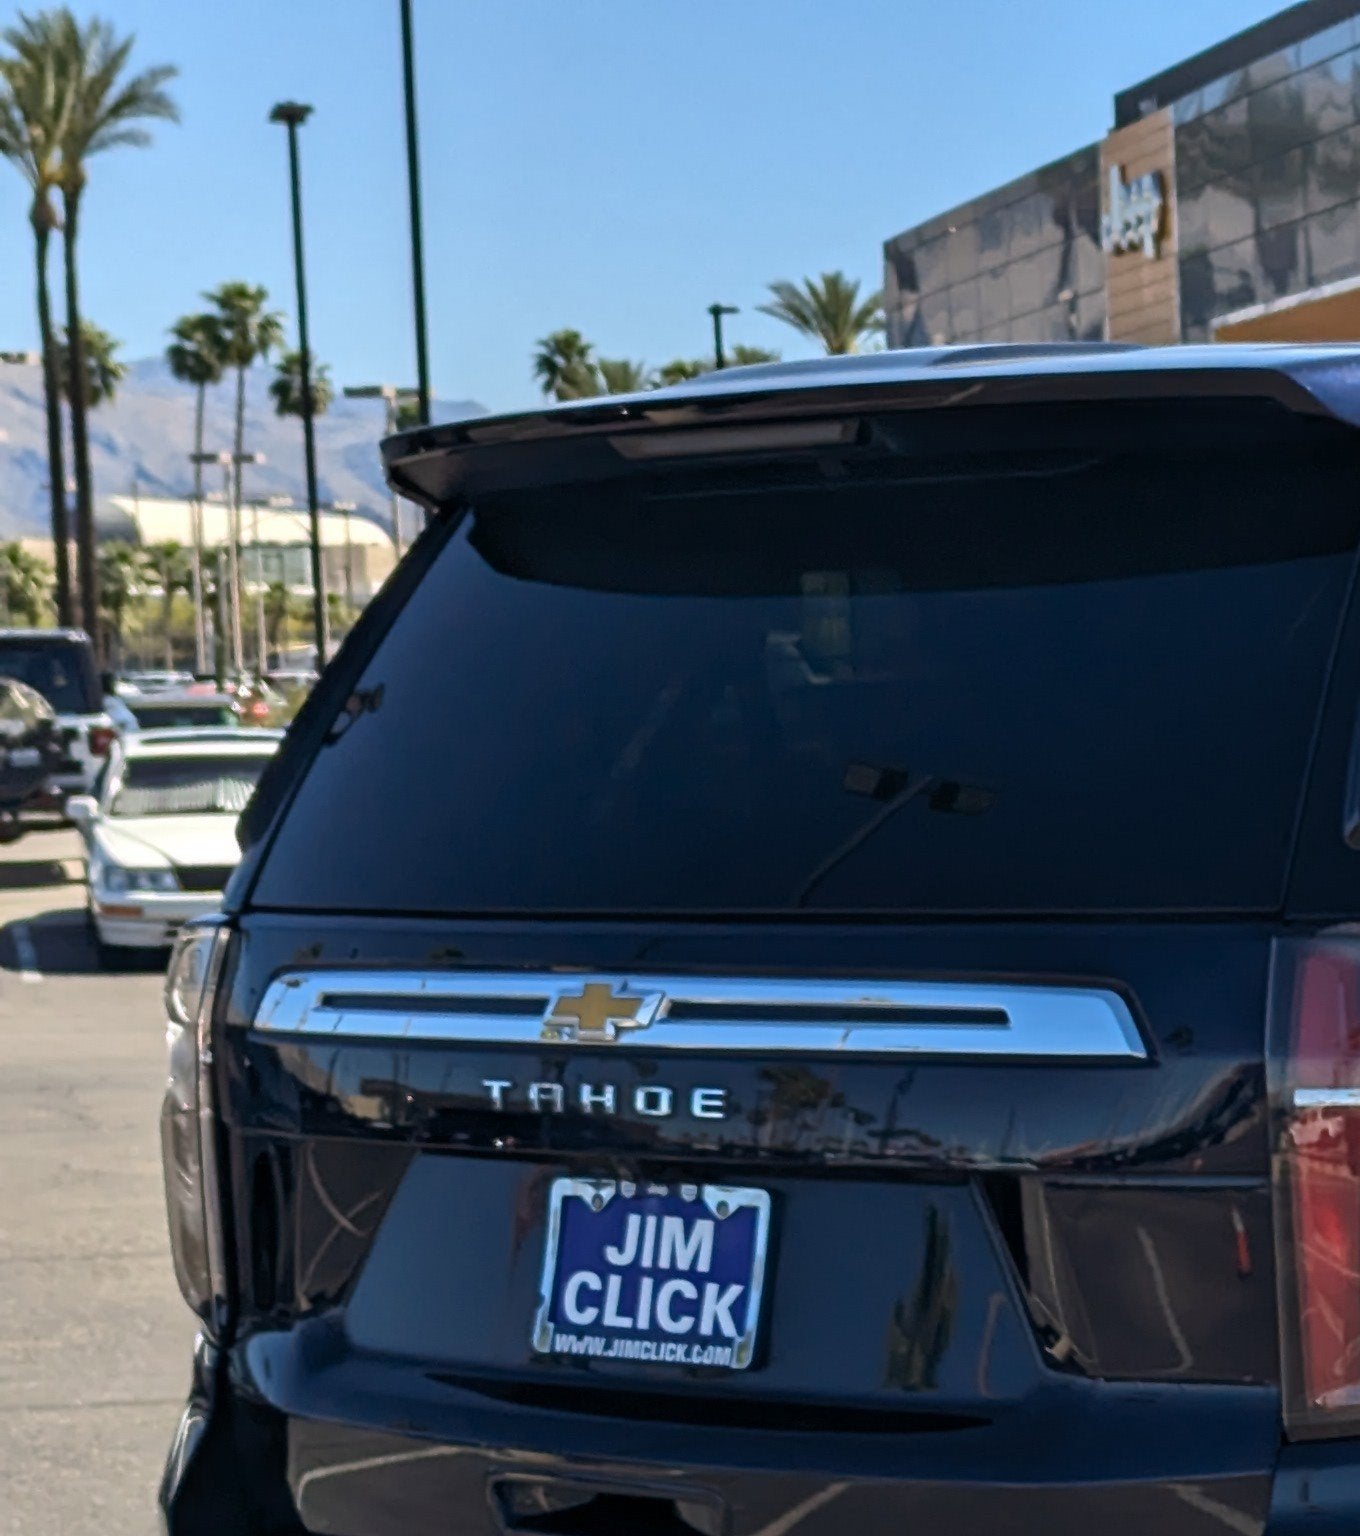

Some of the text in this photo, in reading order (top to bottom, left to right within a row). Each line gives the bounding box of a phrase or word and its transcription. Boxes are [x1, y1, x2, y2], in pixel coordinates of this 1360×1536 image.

[482, 1079, 728, 1119] TAHOE
[604, 1213, 715, 1273] JIM
[563, 1271, 745, 1338] CLICK
[553, 1333, 732, 1366] WWW.JIMCLICK.COM
